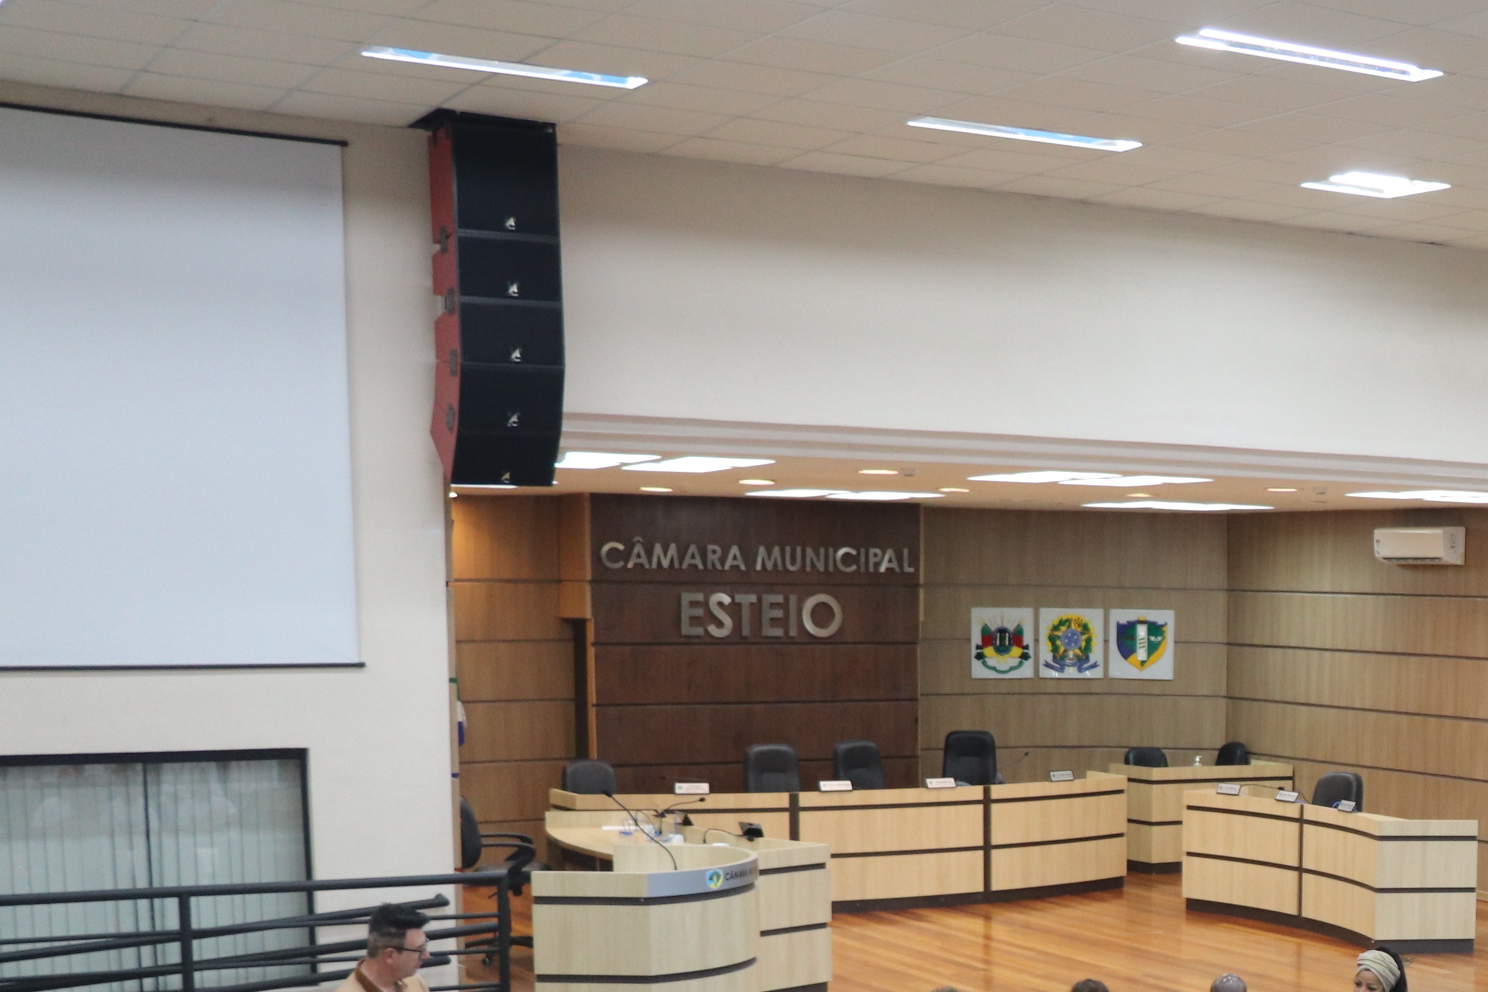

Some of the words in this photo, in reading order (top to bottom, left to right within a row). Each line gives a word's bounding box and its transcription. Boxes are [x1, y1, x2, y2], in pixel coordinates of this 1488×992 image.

[600, 536, 746, 571] CÂMARA
[755, 545, 914, 573] MUNICIPAL
[680, 592, 843, 638] ESTEIO
